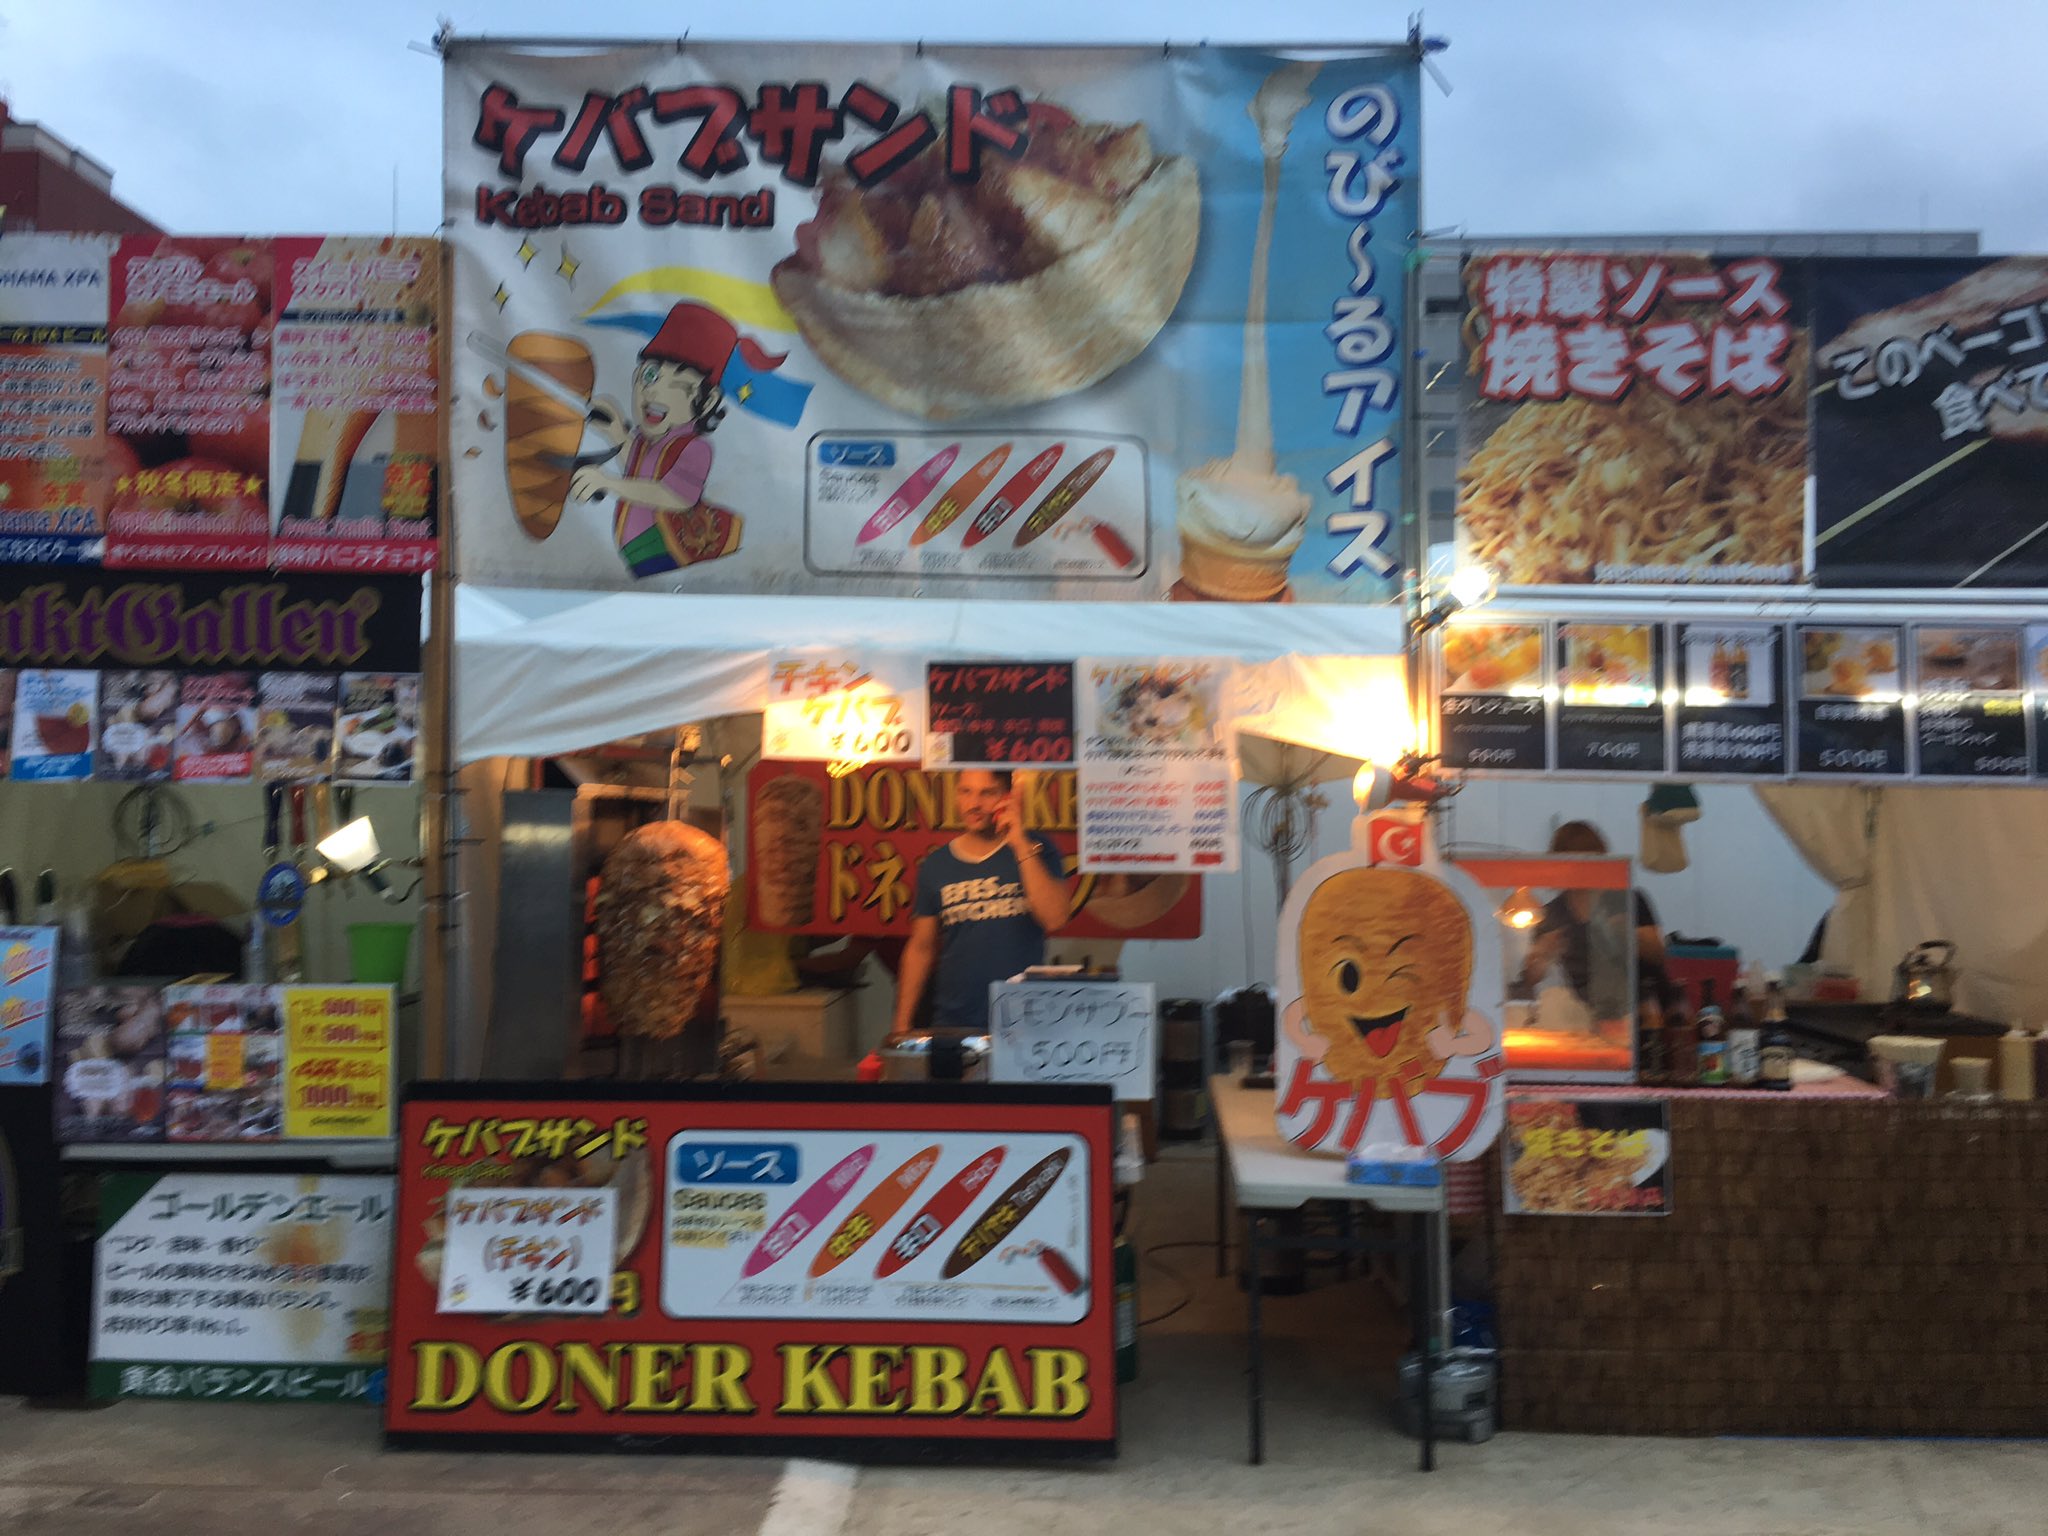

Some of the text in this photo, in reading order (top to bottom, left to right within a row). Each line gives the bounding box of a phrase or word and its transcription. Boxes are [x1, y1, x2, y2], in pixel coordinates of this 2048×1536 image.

[474, 82, 1029, 187] ケバブサンド
[475, 183, 775, 229] Kebab Sand
[1480, 256, 1790, 322] 特製ソース
[1481, 321, 1792, 399] 焼きそば
[1830, 300, 2048, 400] このベーコ
[773, 660, 873, 694] チキン
[930, 666, 1067, 694] ケバブサンド
[985, 736, 1072, 763] ¥600
[1278, 1056, 1502, 1157] ケバブ
[421, 1116, 649, 1160] ケバブサンド
[692, 1150, 785, 1182] ソース
[149, 1189, 389, 1223] ゴールデンエール
[451, 1197, 604, 1226] ケバブサンド
[508, 1276, 602, 1308] ¥600
[411, 1341, 1091, 1421] DONER KEBAB
